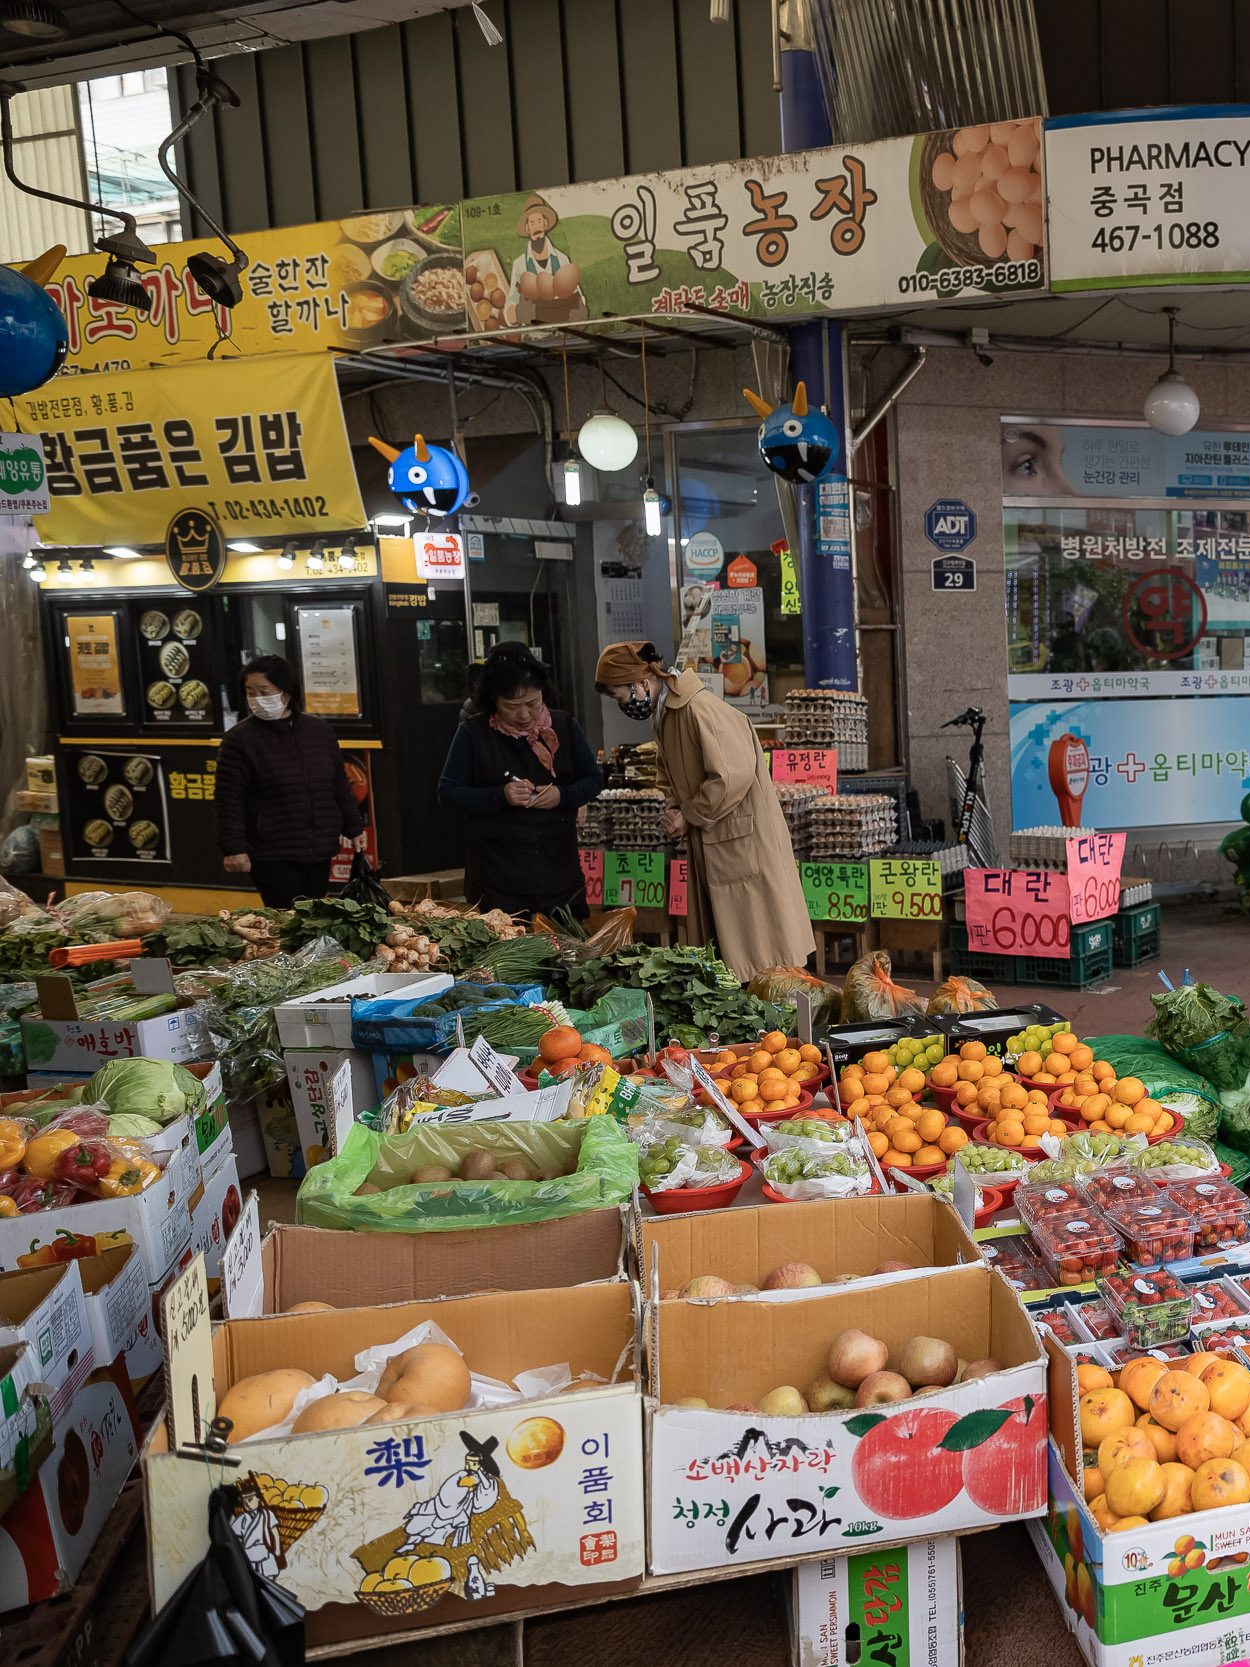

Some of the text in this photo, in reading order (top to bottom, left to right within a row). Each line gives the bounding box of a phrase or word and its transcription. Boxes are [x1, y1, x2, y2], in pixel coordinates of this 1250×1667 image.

[1090, 181, 1185, 218] 중곡점
[610, 155, 878, 286] 일품농장
[1091, 221, 1220, 254] 467-1088
[248, 253, 331, 297] 술한잔
[762, 271, 835, 309] 농장직송
[898, 261, 1040, 295] 010-6383-6818
[267, 292, 351, 334] 할까나
[26, 396, 88, 421] 김밥전문점,
[40, 411, 308, 497] 황금품은 김밥
[1185, 453, 1222, 465] 지아잔틴
[1083, 471, 1141, 486] 눈건강 관리
[933, 516, 969, 535] ADT
[429, 550, 461, 563] 일품농장
[690, 548, 719, 558] HACCP
[1060, 536, 1167, 561] 병원처방전
[944, 572, 964, 587] 29
[1138, 582, 1193, 646] 약
[1051, 676, 1151, 693] 조광 옵티마약국
[1180, 675, 1203, 690] 조광
[786, 751, 827, 772] 유정란
[616, 853, 655, 874] 초란
[1078, 834, 1114, 866] 대란
[879, 861, 940, 888] 큰왕란
[984, 871, 1052, 903] 대란
[76, 1027, 135, 1057] 애호박
[303, 1068, 328, 1134] 고성 단감
[364, 1434, 433, 1489] 梨
[685, 1447, 837, 1485] 소백산자락
[577, 1432, 614, 1525] 이품회
[673, 1493, 879, 1555] 청정 사과 10kg
[1214, 1530, 1236, 1542] MUN
[862, 1563, 903, 1628] 단감
[1134, 1579, 1162, 1597] 진주
[1163, 1575, 1242, 1624] 문산
[829, 1590, 838, 1636] PERSIMMON
